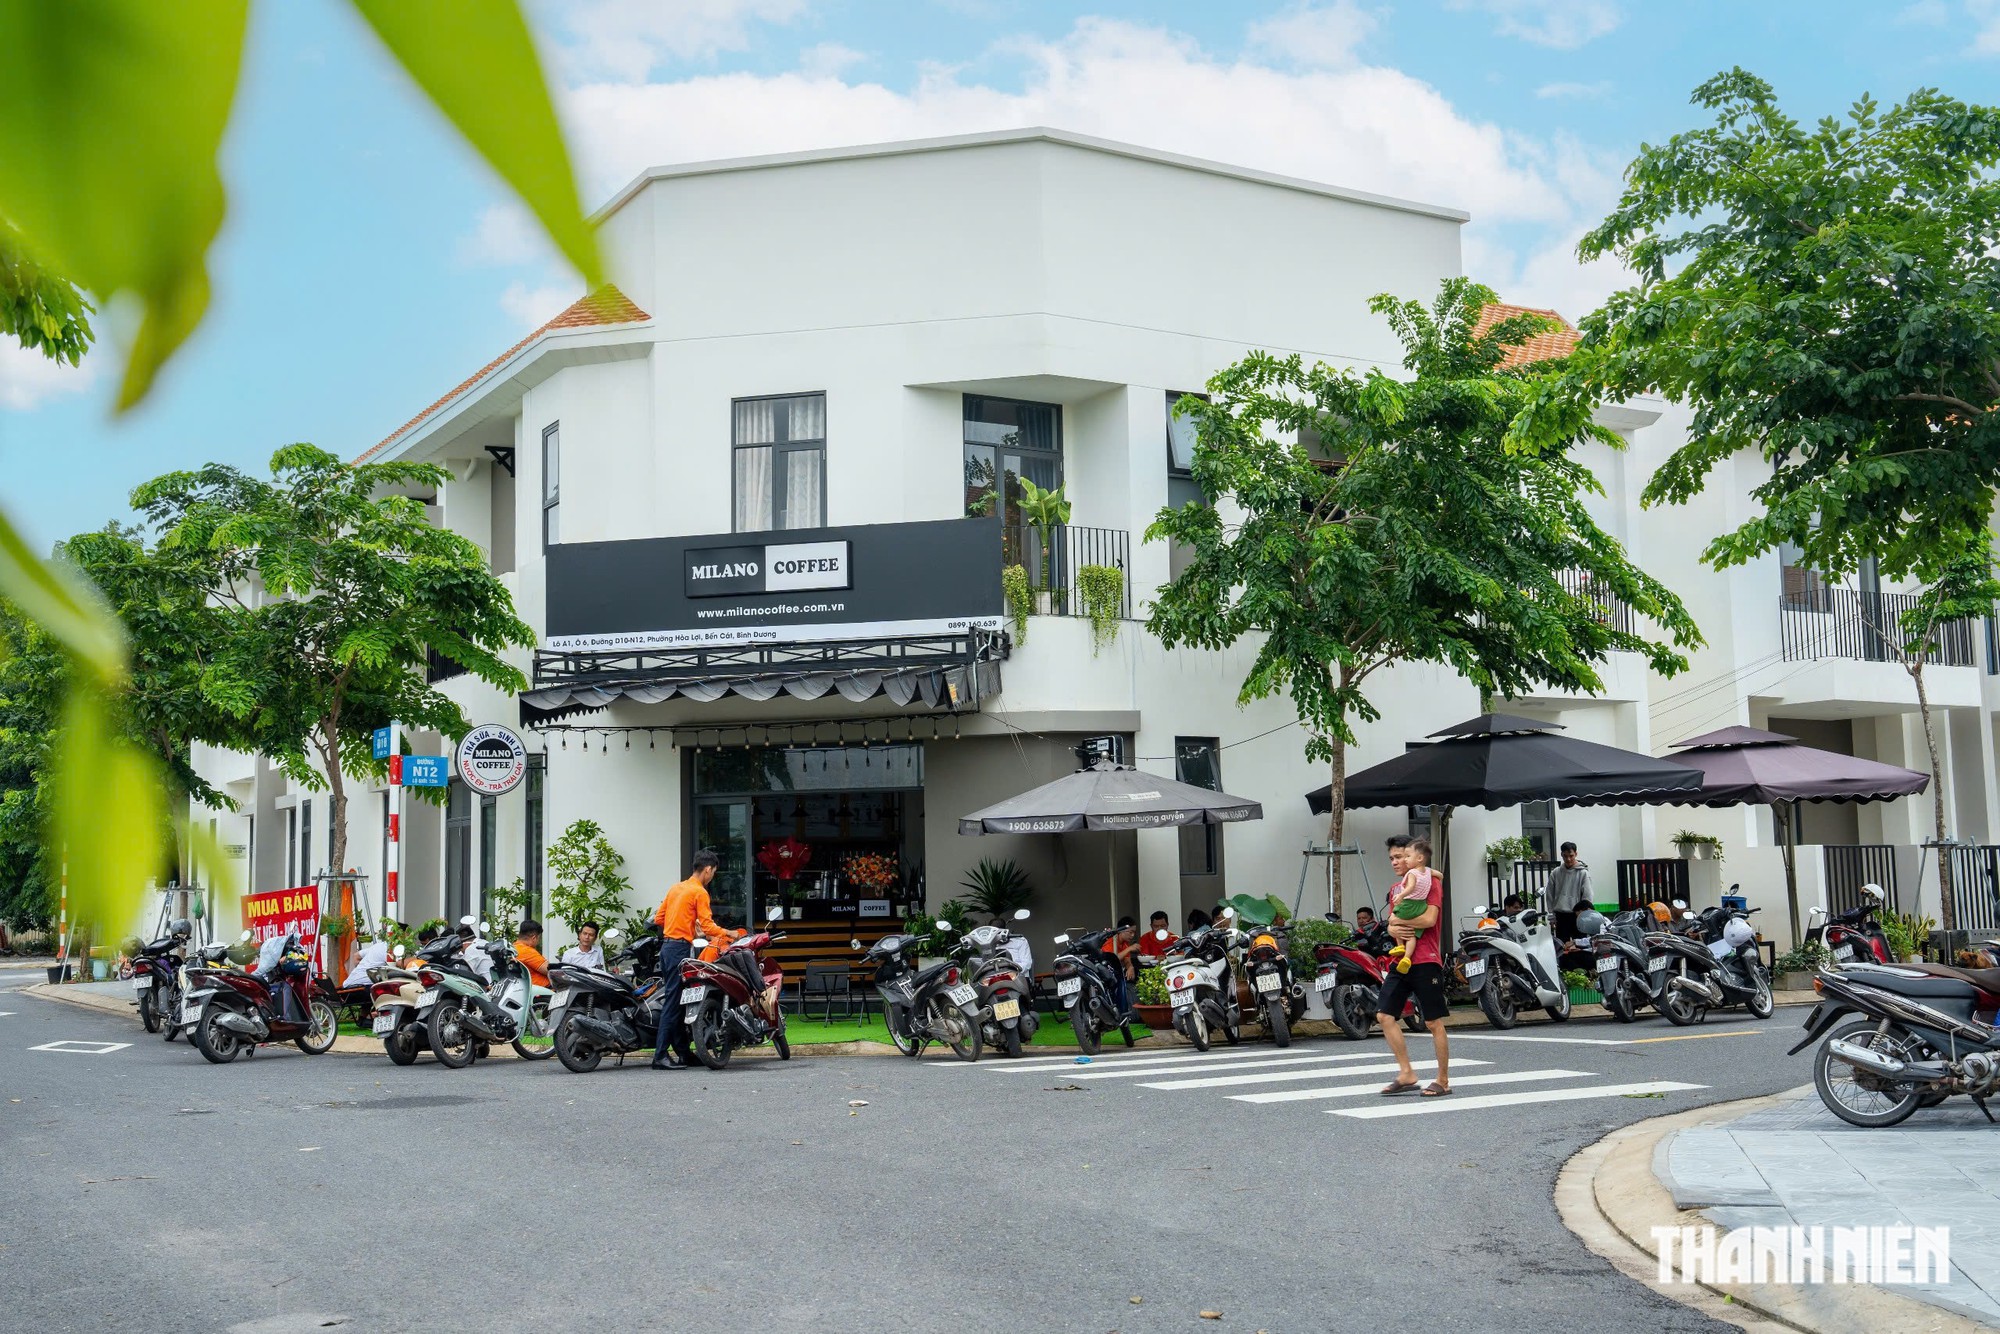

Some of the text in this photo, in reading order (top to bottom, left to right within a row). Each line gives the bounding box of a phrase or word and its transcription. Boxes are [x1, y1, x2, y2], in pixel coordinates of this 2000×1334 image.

[692, 557, 839, 580] MILANO COFFEE
[697, 603, 845, 618] www.milanocoffee.com.vn
[948, 620, 997, 628] 0899.160.639
[647, 634, 674, 645] Phường
[675, 633, 690, 641] Hòa
[704, 631, 718, 640] Bến
[736, 630, 752, 639] Bình
[753, 630, 777, 640] Dương
[464, 741, 476, 756] TRÀ
[474, 730, 490, 742] SỮA
[498, 731, 515, 746] SINH
[513, 745, 525, 756] TỐ
[475, 749, 511, 758] MILANO
[412, 766, 438, 777] N12
[476, 761, 510, 769] COFFEE
[1103, 811, 1184, 824] Hotline nhượng quyền
[1009, 820, 1064, 831] 1900 636873
[247, 892, 313, 918] MUA BÁN
[301, 913, 315, 936] PHỐ
